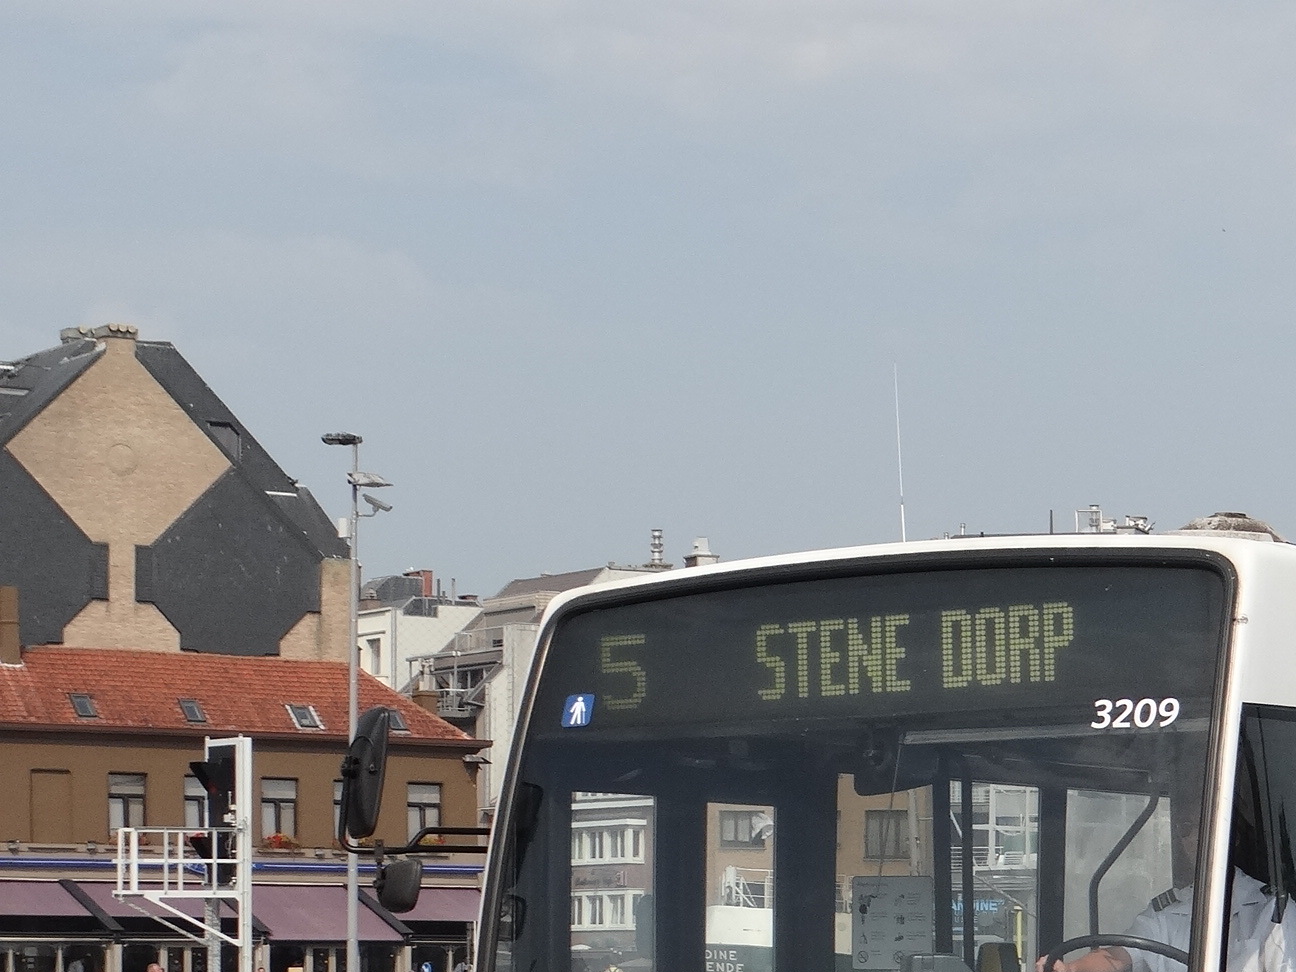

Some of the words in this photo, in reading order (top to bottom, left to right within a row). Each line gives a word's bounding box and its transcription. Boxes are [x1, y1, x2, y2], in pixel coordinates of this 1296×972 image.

[600, 634, 647, 709] 5
[756, 613, 911, 700] STENE
[941, 601, 1075, 689] DORP
[1090, 697, 1181, 729] 3209
